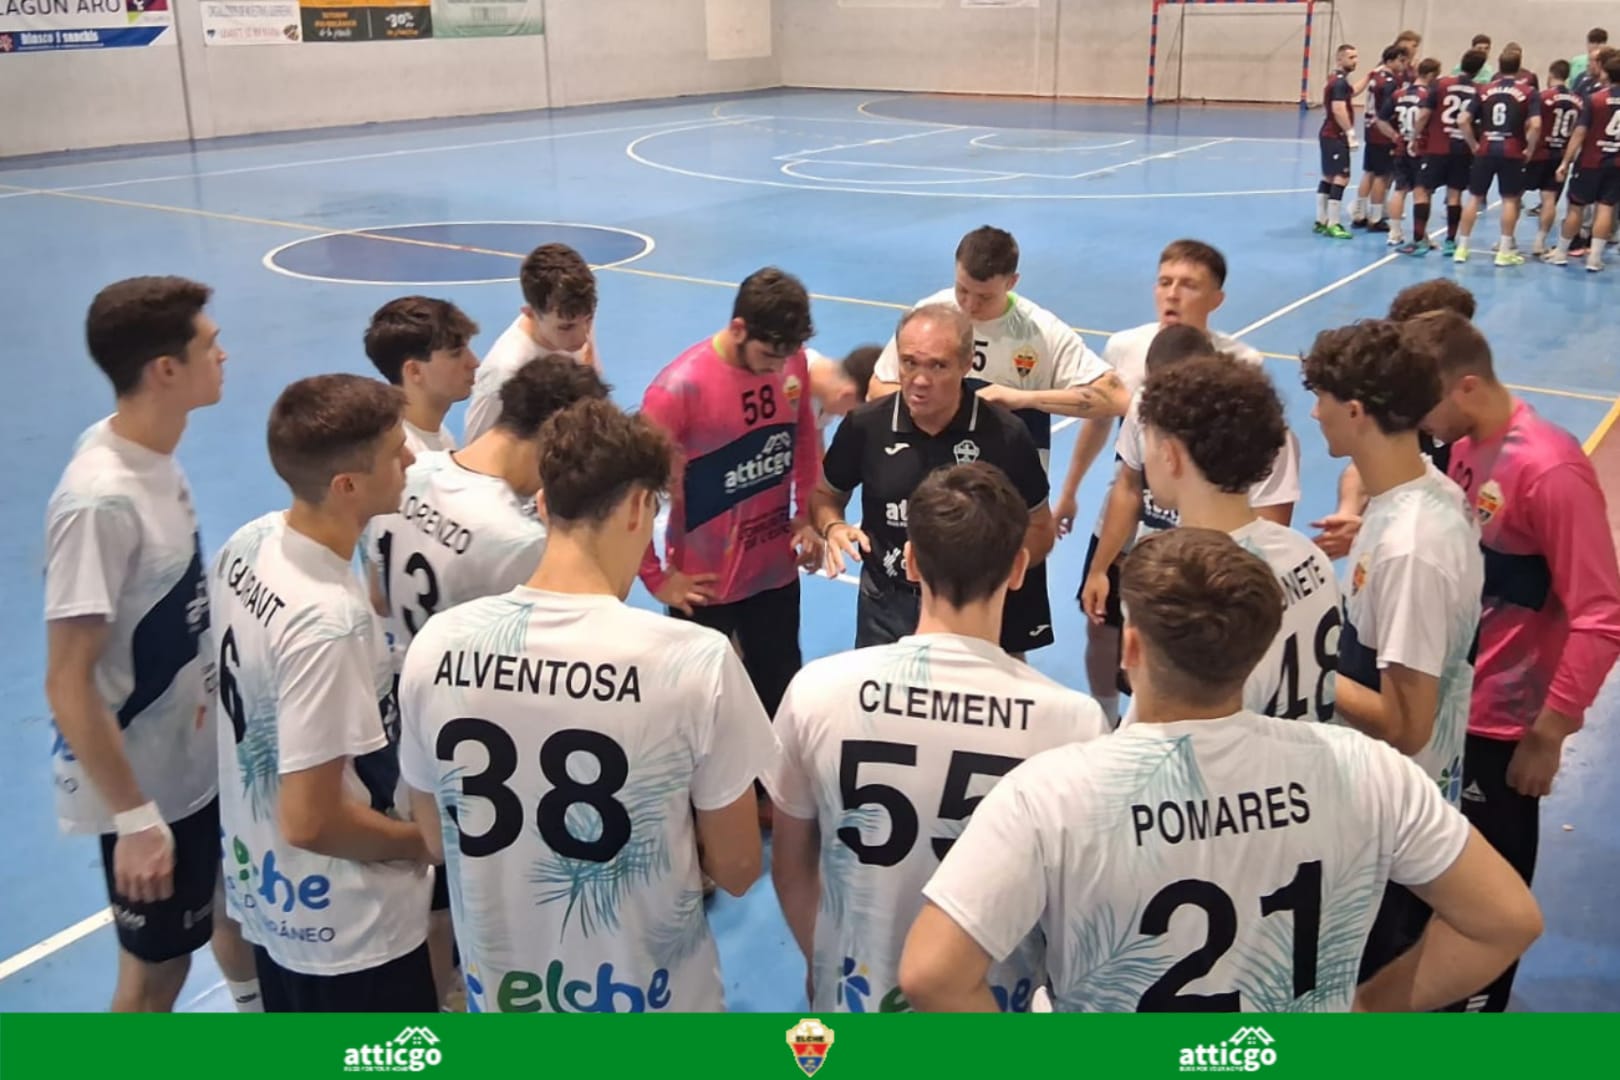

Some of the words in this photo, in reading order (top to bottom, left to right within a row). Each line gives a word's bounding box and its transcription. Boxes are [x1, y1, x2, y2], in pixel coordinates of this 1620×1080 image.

[1492, 102, 1507, 127] 6
[1553, 108, 1579, 138] 10
[741, 384, 776, 426] 58
[399, 495, 473, 555] ORENZO
[377, 530, 441, 638] 13
[1280, 554, 1326, 612] NETE
[434, 650, 641, 703] ALVENTOSA
[859, 680, 1035, 730] CLEMENT
[436, 717, 632, 863] 38
[837, 740, 1026, 867] 55
[1131, 781, 1310, 847] POMARES
[1136, 860, 1322, 1012] 21
[497, 959, 671, 1013] elche
